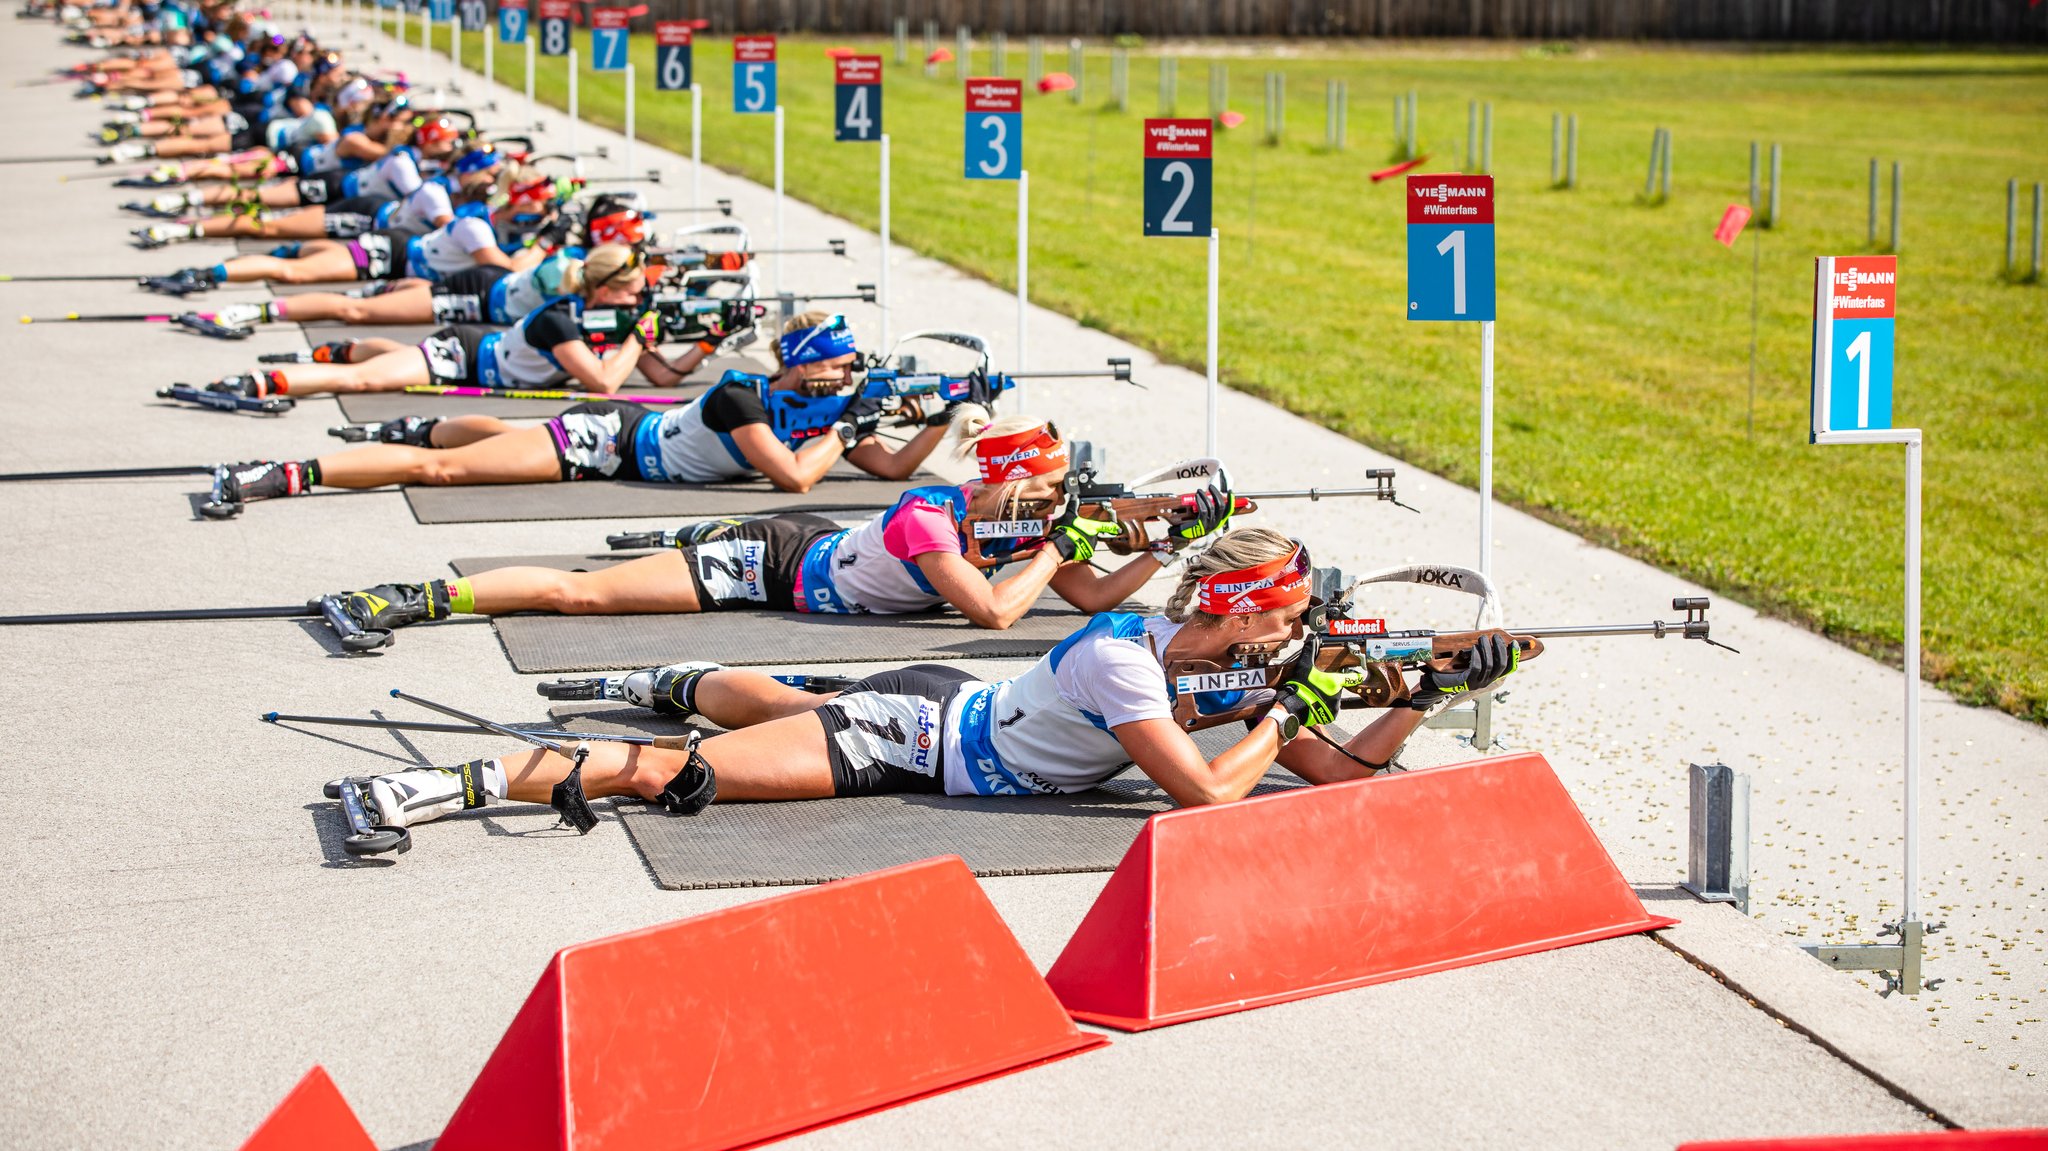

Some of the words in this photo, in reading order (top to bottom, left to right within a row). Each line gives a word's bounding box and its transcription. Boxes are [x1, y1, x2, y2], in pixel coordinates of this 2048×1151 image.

[462, 1, 487, 30] 10
[504, 9, 519, 42] 9
[545, 18, 564, 54] 8
[601, 30, 620, 69] 7
[663, 46, 685, 89] 6
[744, 64, 766, 111] 5
[844, 86, 873, 139] 4
[978, 115, 1008, 176] 3
[1150, 125, 1207, 141] VIESSMANN
[1161, 161, 1194, 232] 2
[1415, 184, 1486, 202] VIESSMANN
[1424, 205, 1478, 215] #Winterfans
[1436, 230, 1466, 314] 1
[1834, 267, 1894, 291] IESSMANN
[1845, 331, 1871, 428] 1
[976, 521, 1041, 535] E.INFRA
[701, 554, 744, 581] 2
[745, 545, 760, 597] infront
[837, 554, 857, 569] 2
[1415, 568, 1463, 588] JOKA
[1229, 606, 1262, 614] adidas
[1334, 619, 1380, 634] Nudossi
[1178, 670, 1265, 693] E.INFRA
[852, 716, 906, 745] 1
[998, 707, 1026, 729] 1
